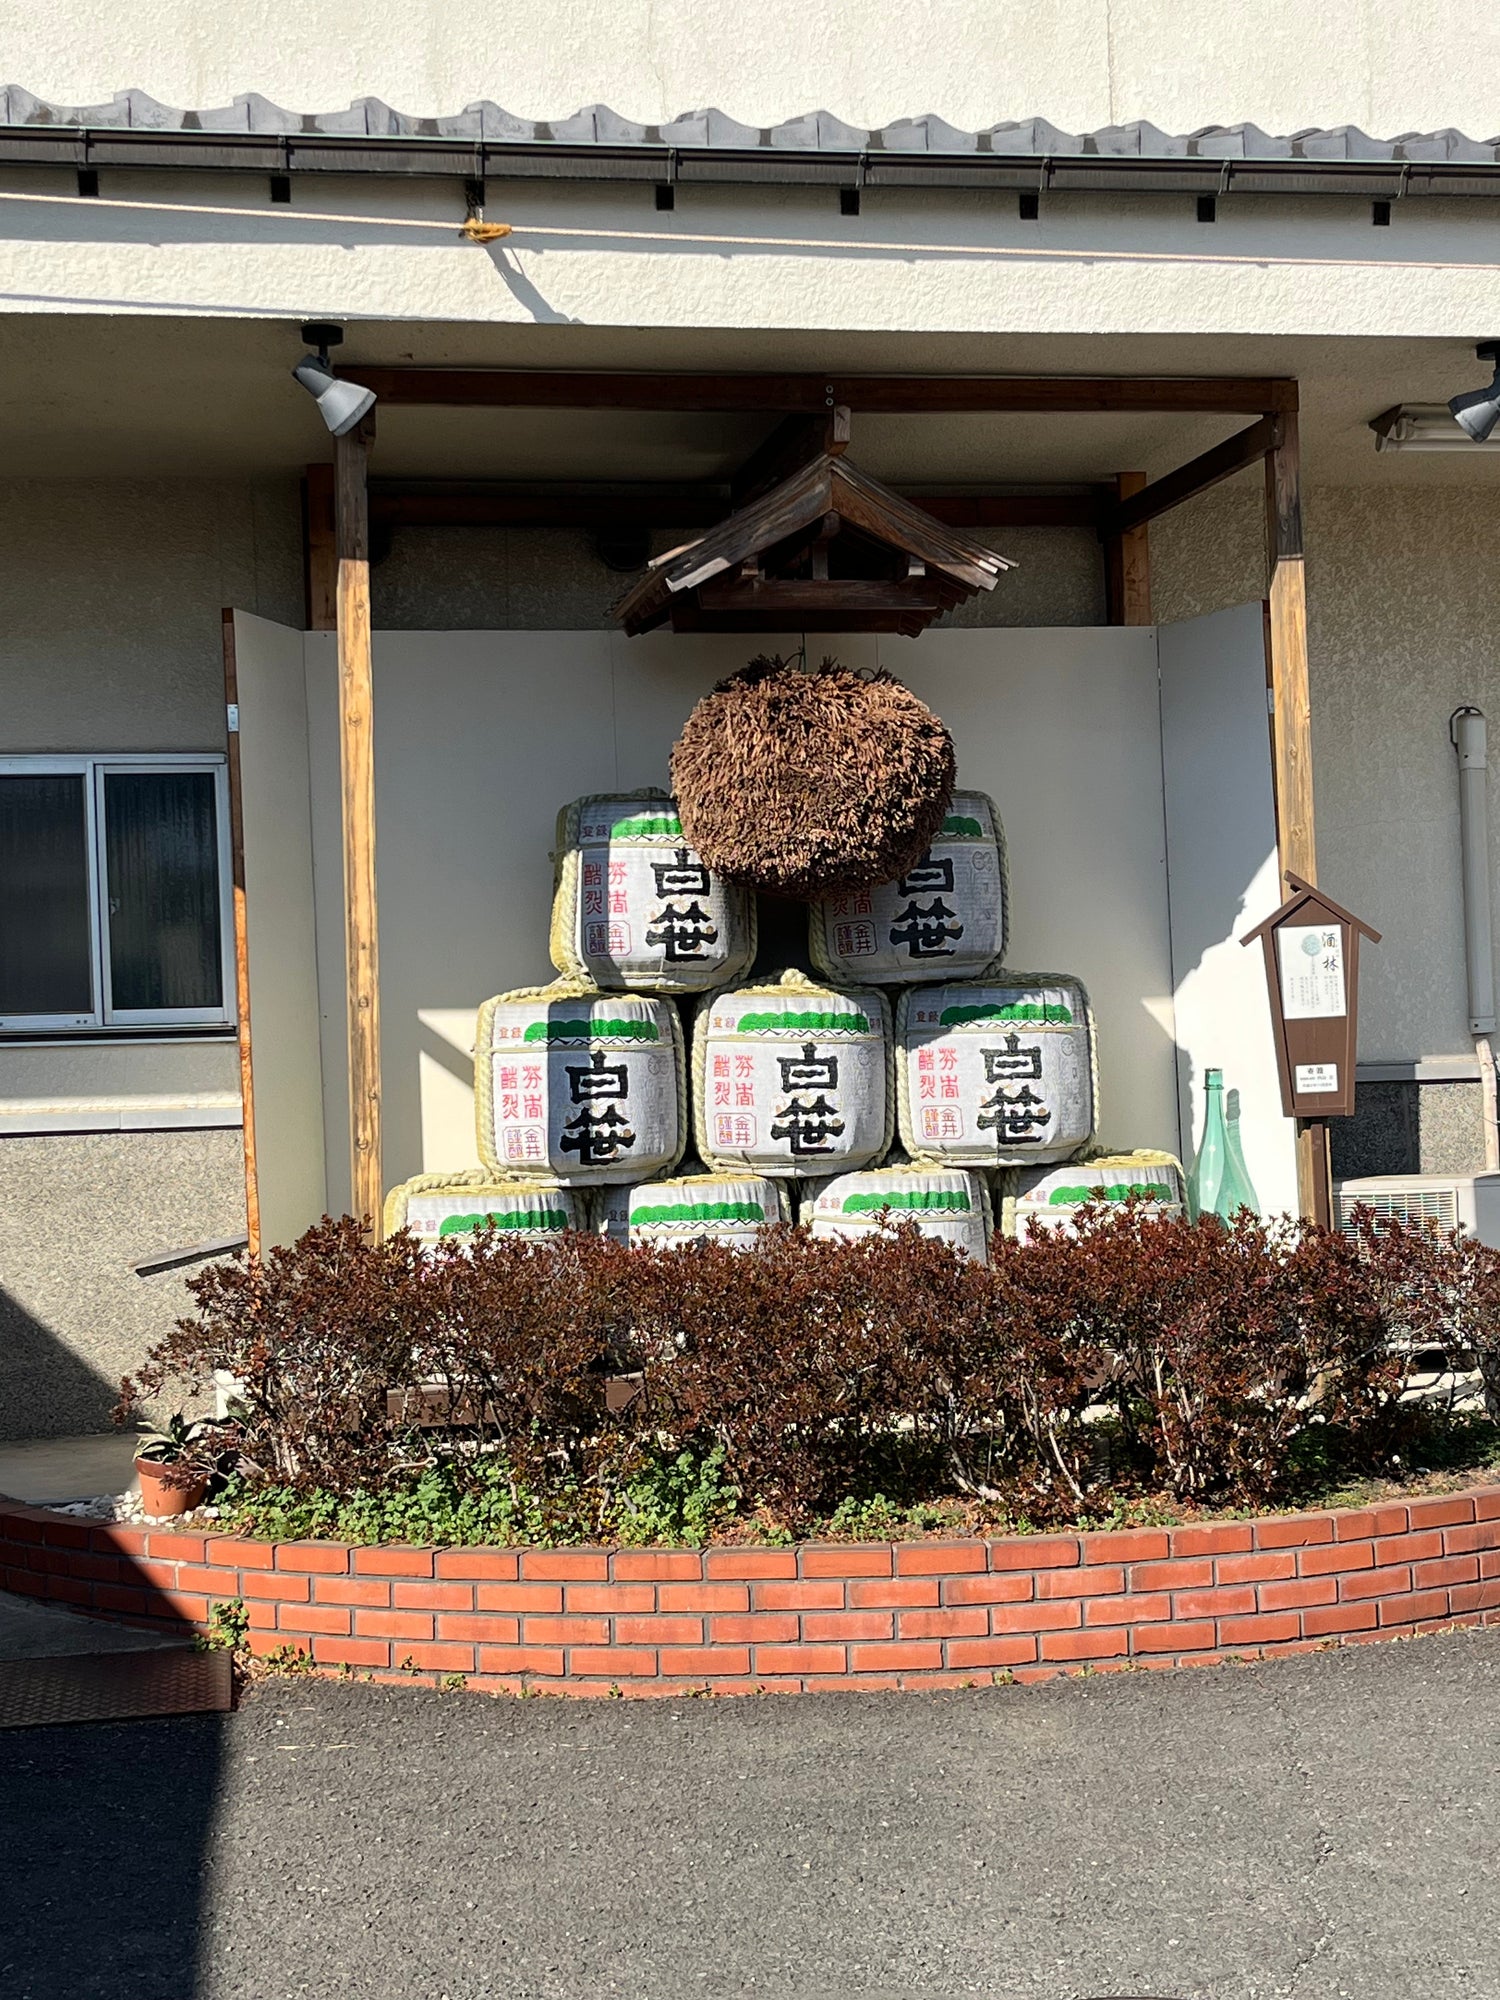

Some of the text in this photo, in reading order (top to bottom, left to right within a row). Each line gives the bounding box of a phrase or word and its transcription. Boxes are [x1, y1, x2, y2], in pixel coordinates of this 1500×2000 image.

[609, 923, 625, 952] 金井
[645, 848, 718, 962] 白笹
[889, 850, 964, 958] 白笹
[854, 924, 872, 953] 金井
[560, 1050, 636, 1165] 白笹
[770, 1042, 845, 1155] 白笹
[941, 1108, 957, 1136] 金井
[977, 1032, 1051, 1144] 白笹
[524, 1129, 541, 1157] 金井
[735, 1116, 751, 1144] 金井
